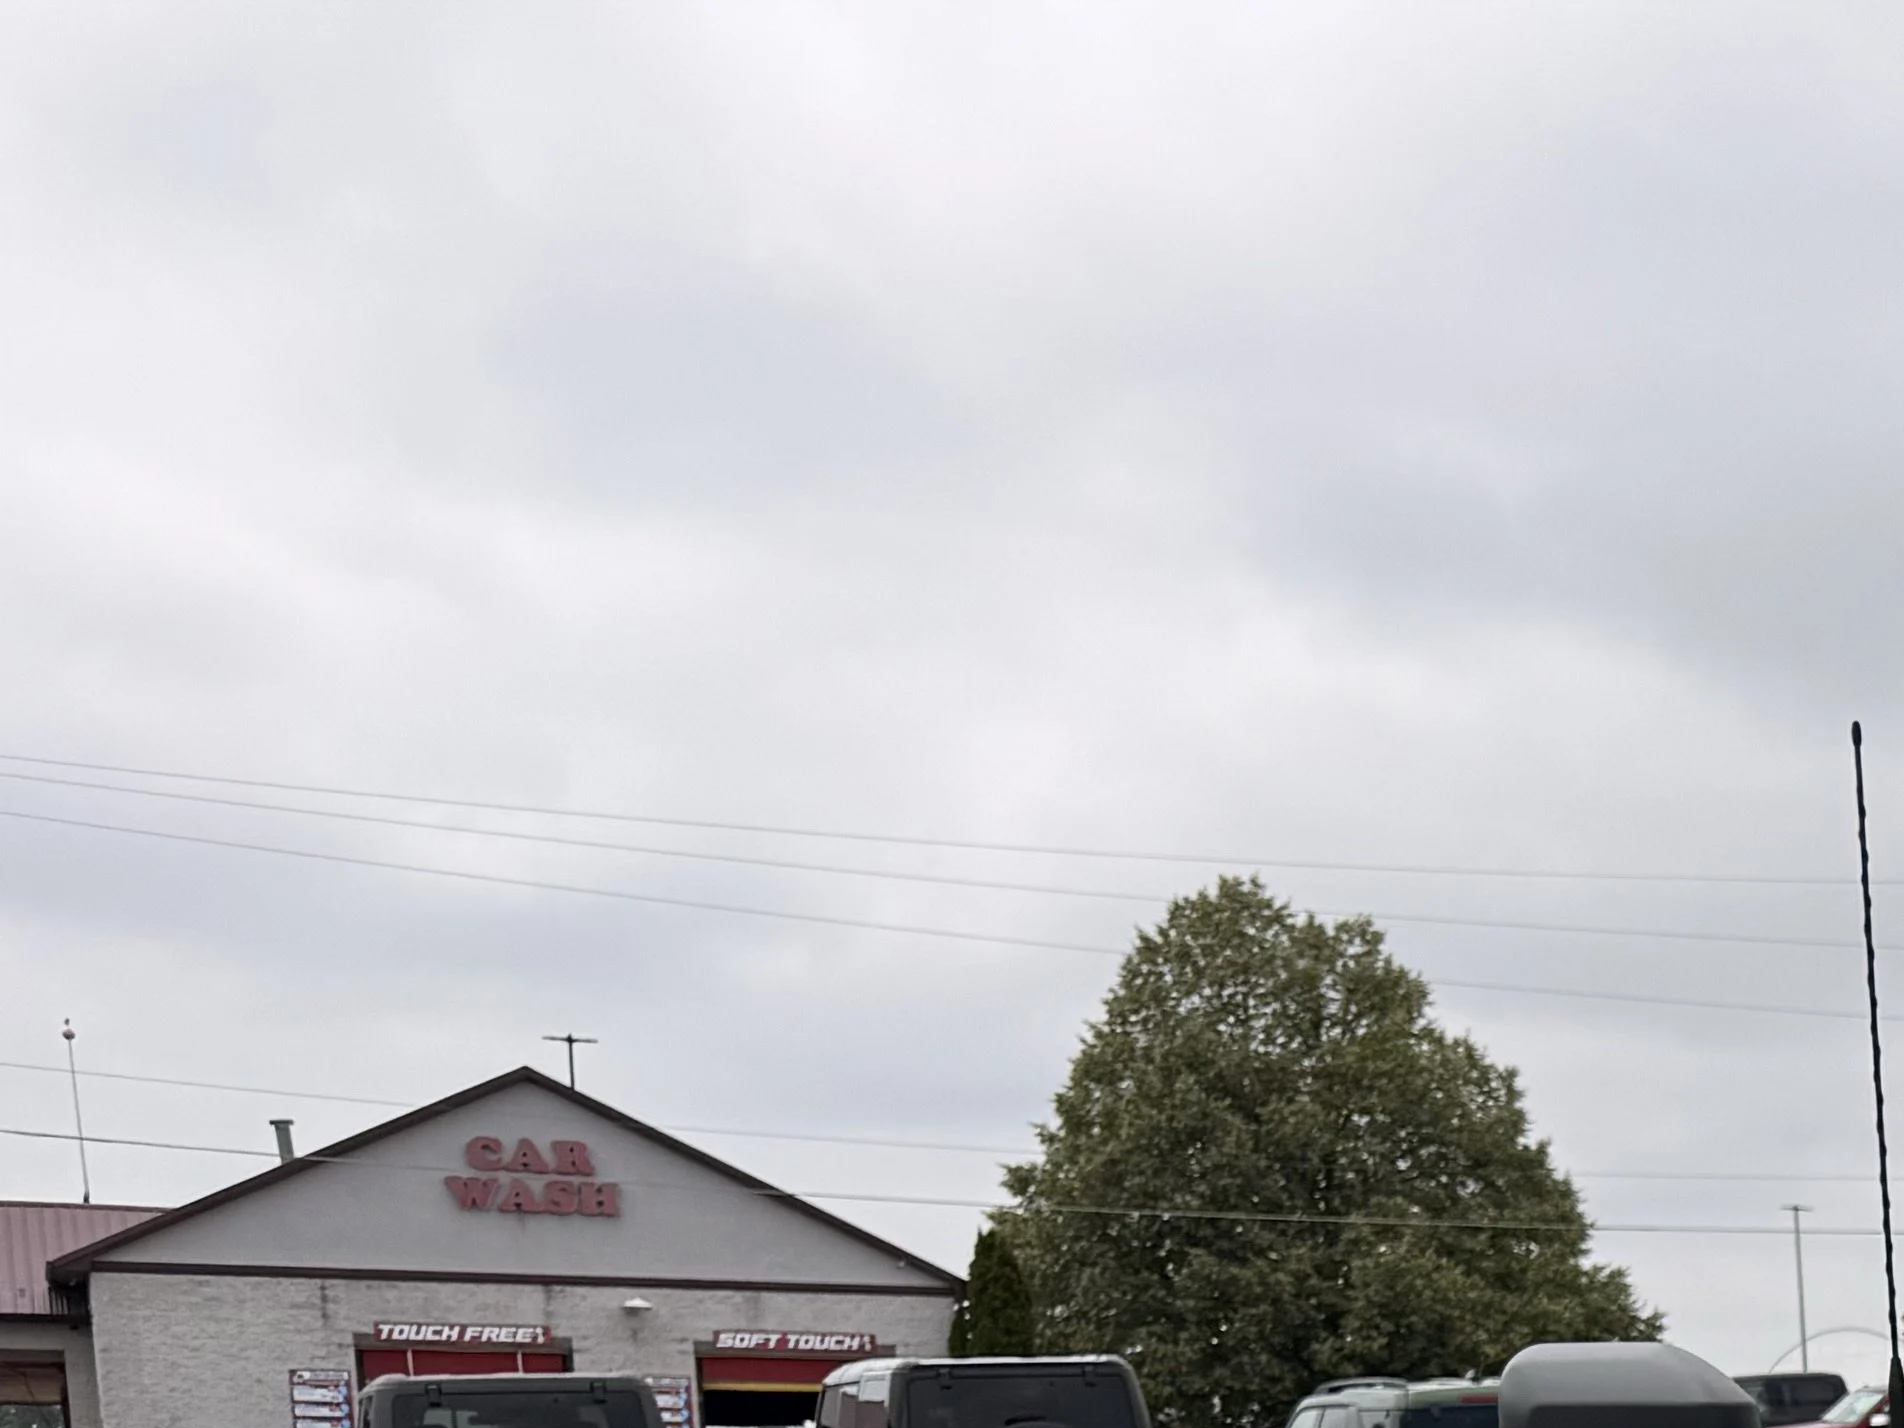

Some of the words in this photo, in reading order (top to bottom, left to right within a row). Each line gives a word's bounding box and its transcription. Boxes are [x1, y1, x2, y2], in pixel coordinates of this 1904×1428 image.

[465, 1136, 594, 1176] CAR
[443, 1175, 620, 1217] WASH
[377, 1323, 460, 1342] TOUCH
[716, 1332, 780, 1349] SOFT
[785, 1334, 861, 1351] TOUCH
